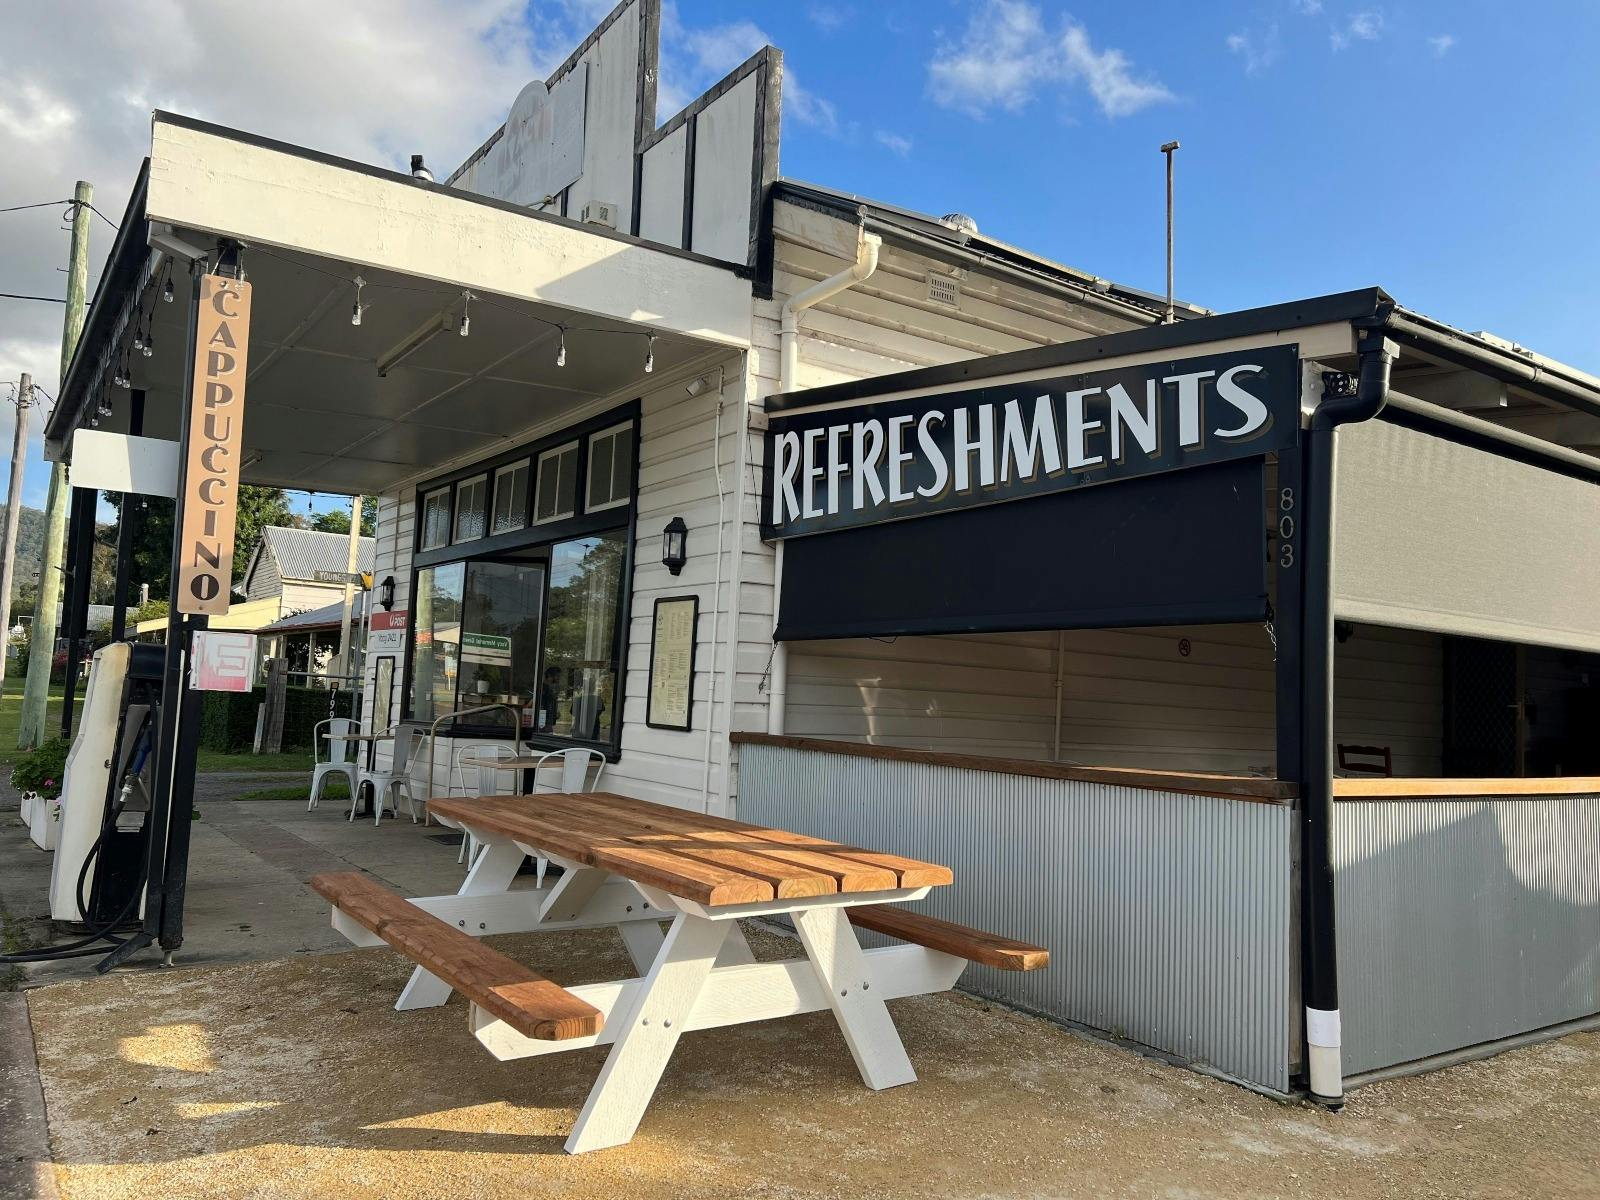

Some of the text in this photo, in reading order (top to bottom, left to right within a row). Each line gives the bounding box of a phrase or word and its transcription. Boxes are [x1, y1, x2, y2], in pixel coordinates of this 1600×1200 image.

[191, 290, 239, 600] CAPPUCCINO
[772, 364, 1270, 525] REFRESHMENTS
[1280, 487, 1294, 568] 803
[394, 616, 406, 627] POST
